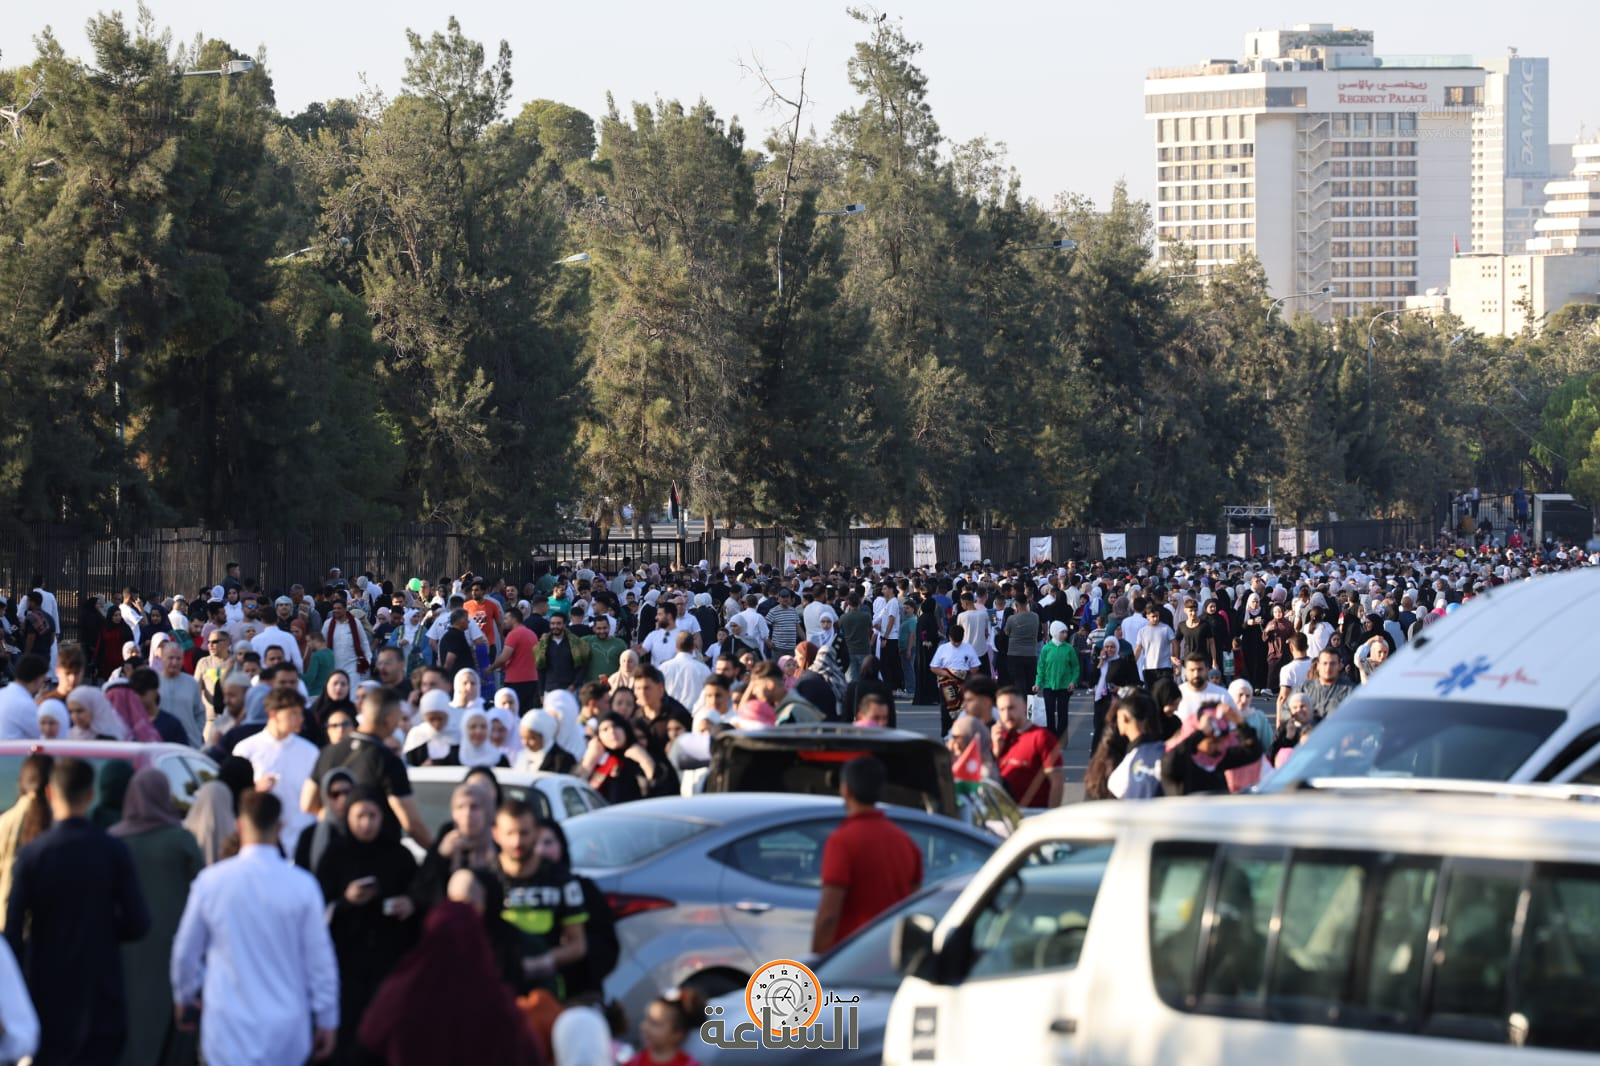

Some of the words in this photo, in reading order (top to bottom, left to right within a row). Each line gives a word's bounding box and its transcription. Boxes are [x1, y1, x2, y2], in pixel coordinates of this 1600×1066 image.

[1338, 94, 1386, 104] REGENCY
[1389, 93, 1428, 104] PALACE
[1521, 61, 1534, 166] DAMAC
